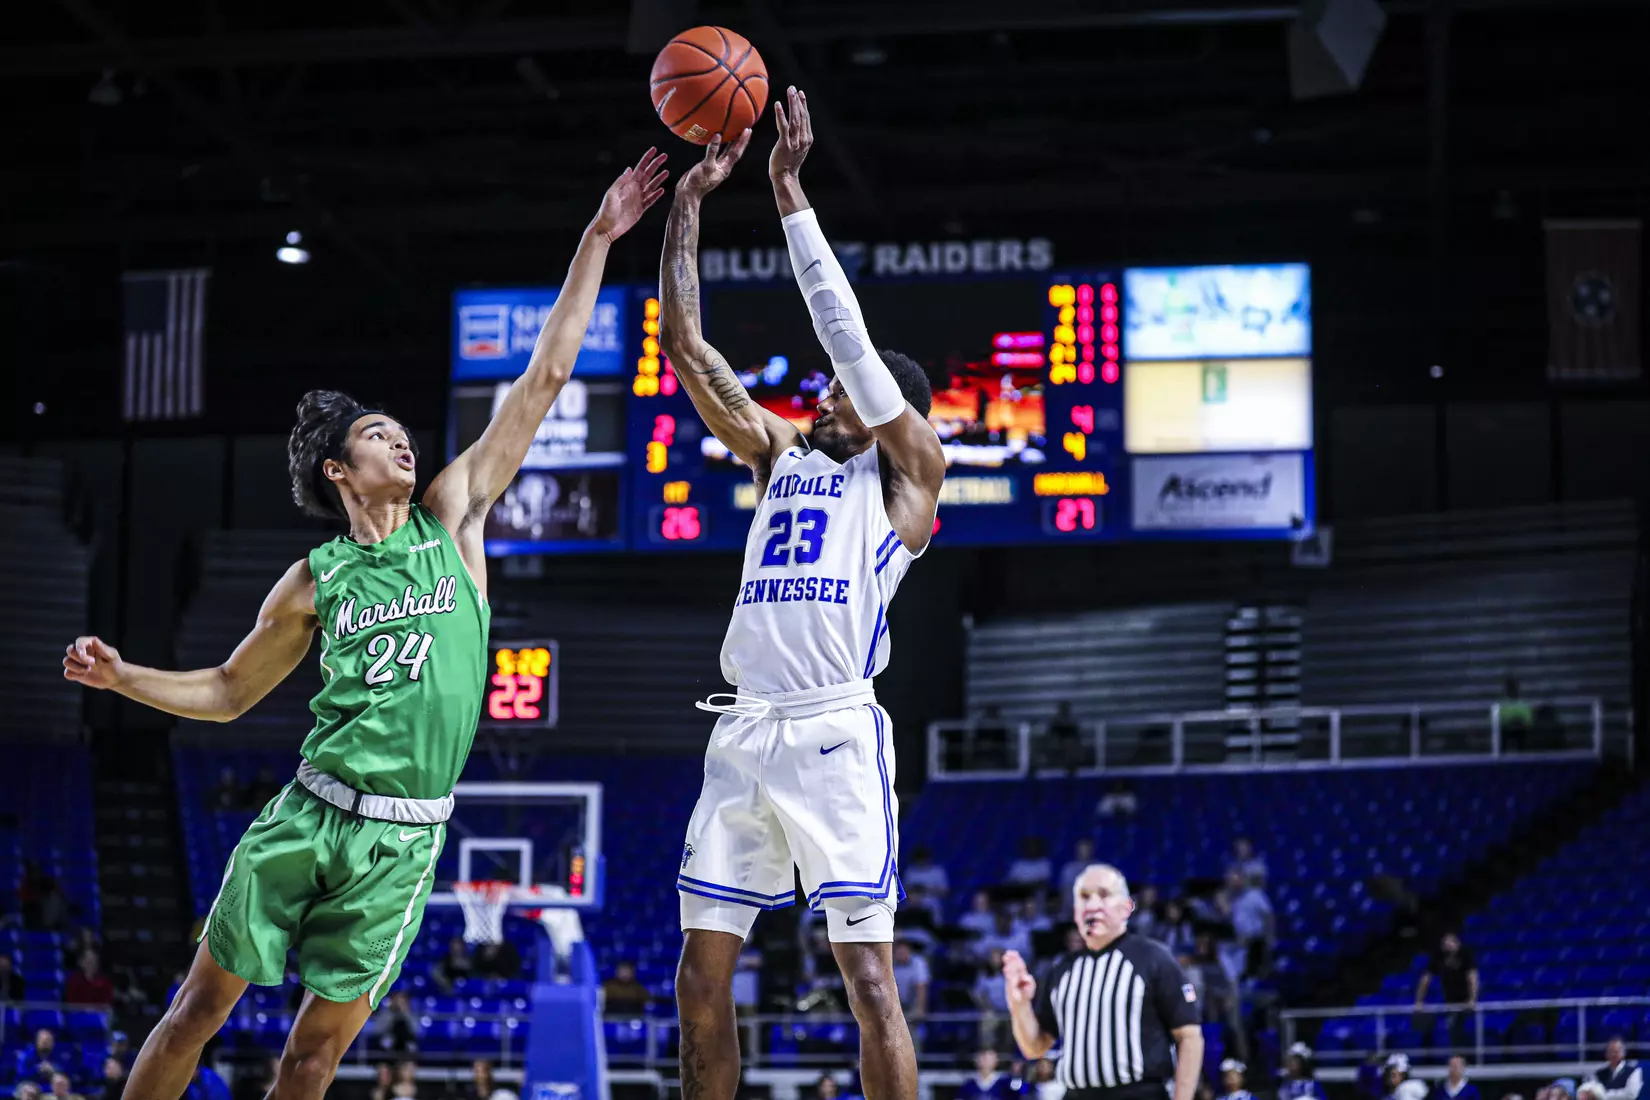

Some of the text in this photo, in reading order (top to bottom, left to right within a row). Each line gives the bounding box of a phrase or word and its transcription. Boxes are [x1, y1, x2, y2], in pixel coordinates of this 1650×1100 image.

[873, 237, 1055, 276] RAIDERS
[1159, 473, 1272, 507] Ascend
[759, 506, 830, 569] 23
[1055, 498, 1095, 531] 27
[334, 575, 456, 640] Marshall
[361, 631, 434, 686] 24
[488, 673, 543, 719] 22
